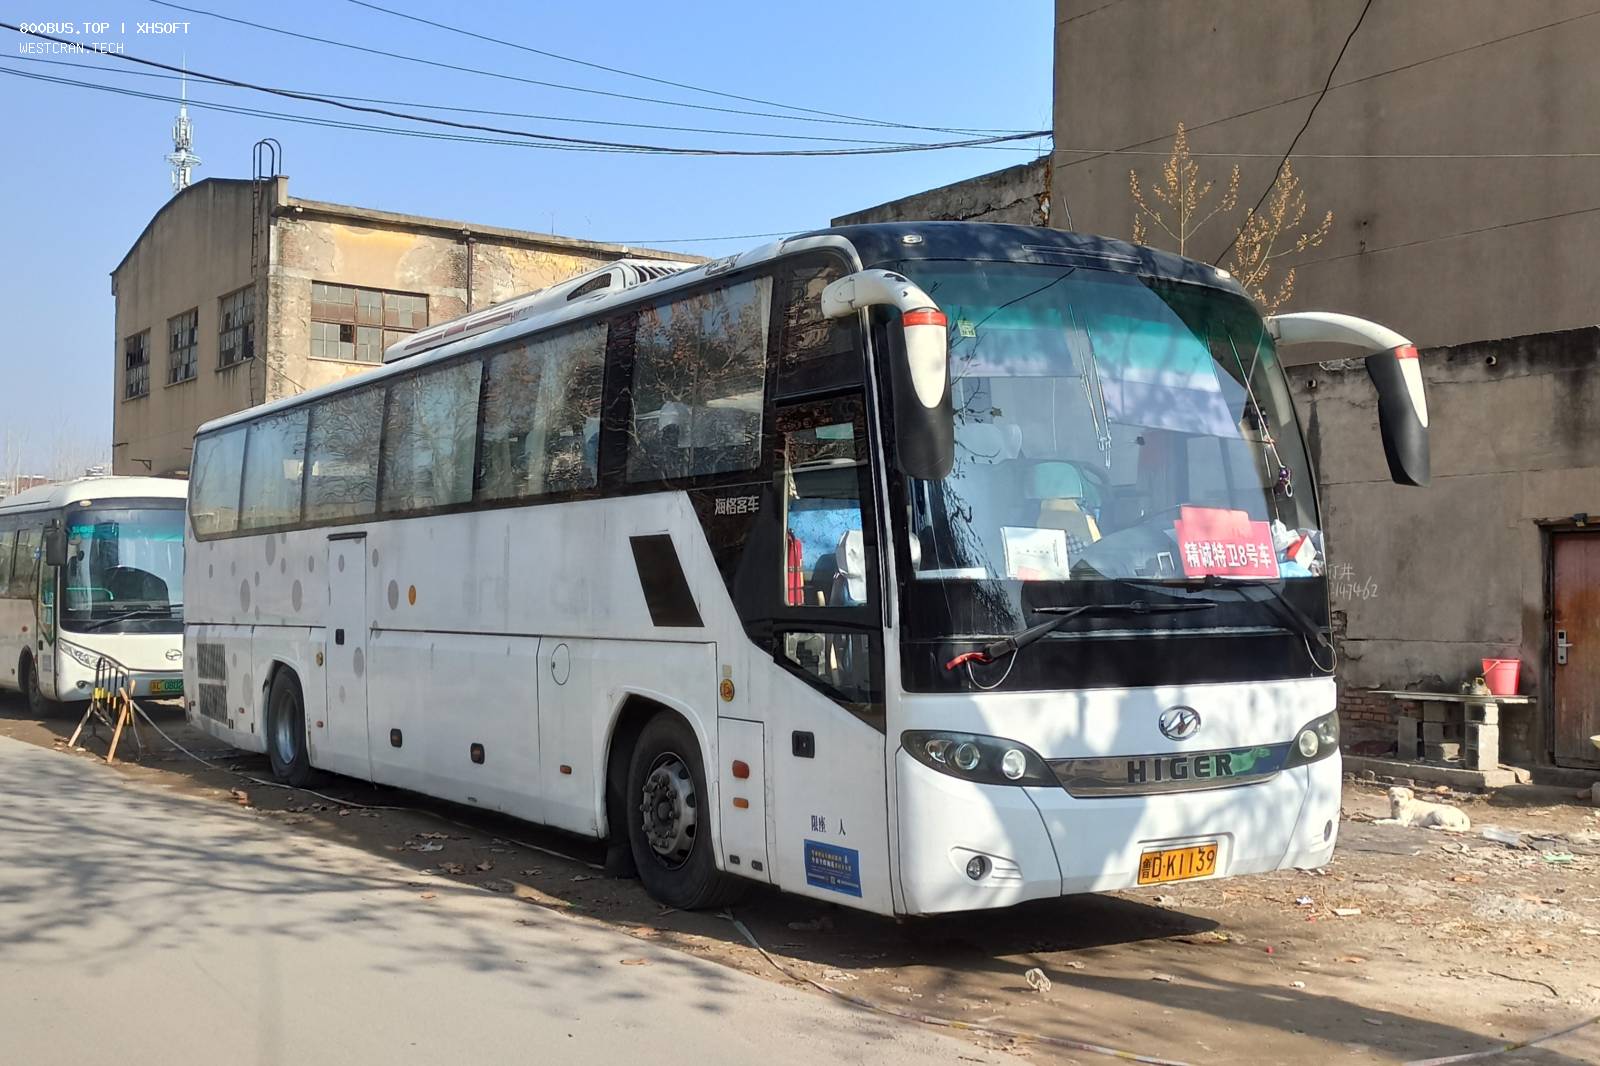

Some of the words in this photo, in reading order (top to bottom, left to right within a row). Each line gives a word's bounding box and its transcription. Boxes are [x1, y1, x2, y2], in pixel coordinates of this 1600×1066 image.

[714, 495, 760, 516] 海格客车
[1184, 541, 1272, 569] 精诚特卫8号车
[1127, 752, 1234, 784] HIGER
